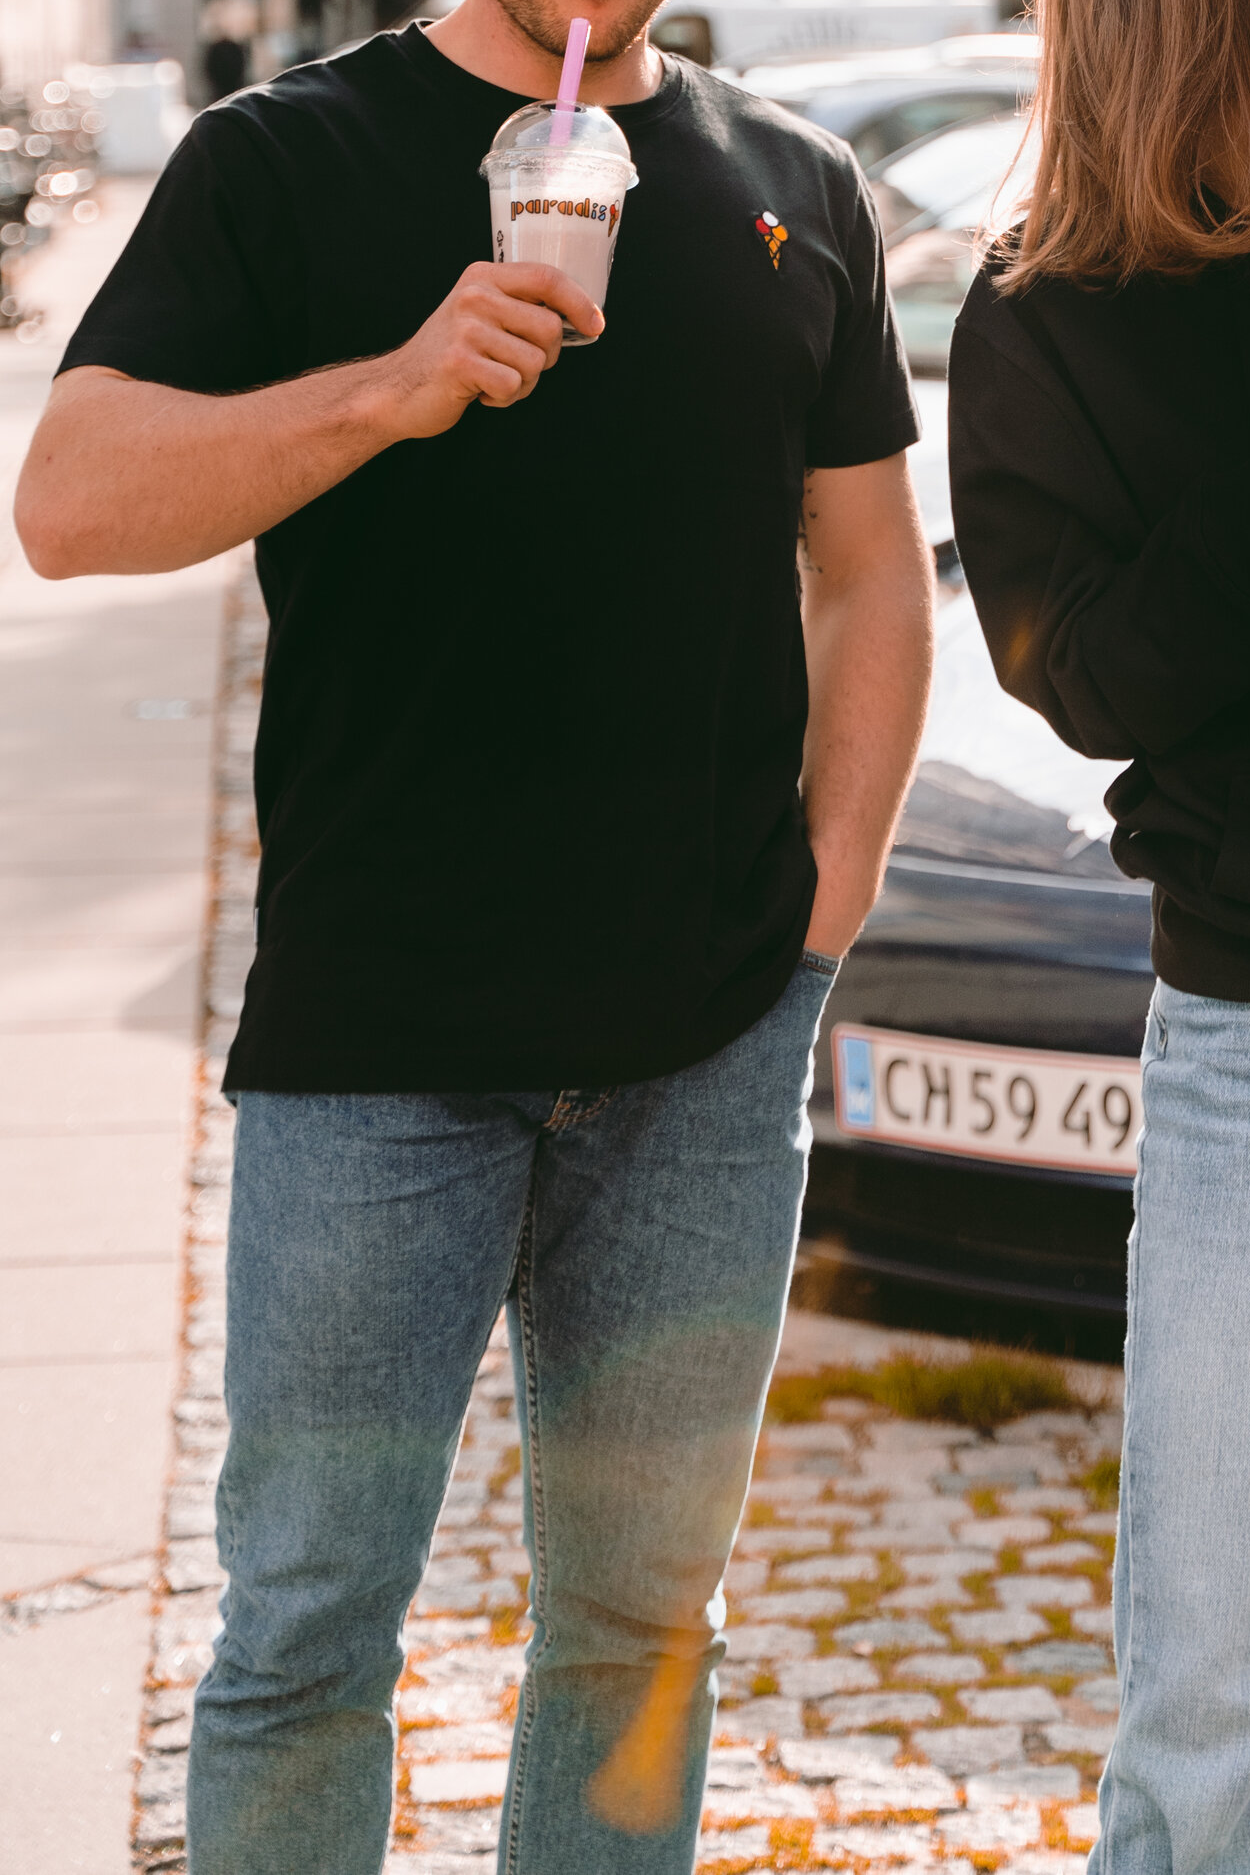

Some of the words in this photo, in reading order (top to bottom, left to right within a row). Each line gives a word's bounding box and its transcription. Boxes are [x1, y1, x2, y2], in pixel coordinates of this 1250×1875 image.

[510, 197, 607, 222] paradis
[884, 1056, 952, 1127] CH
[970, 1069, 1037, 1142] 59
